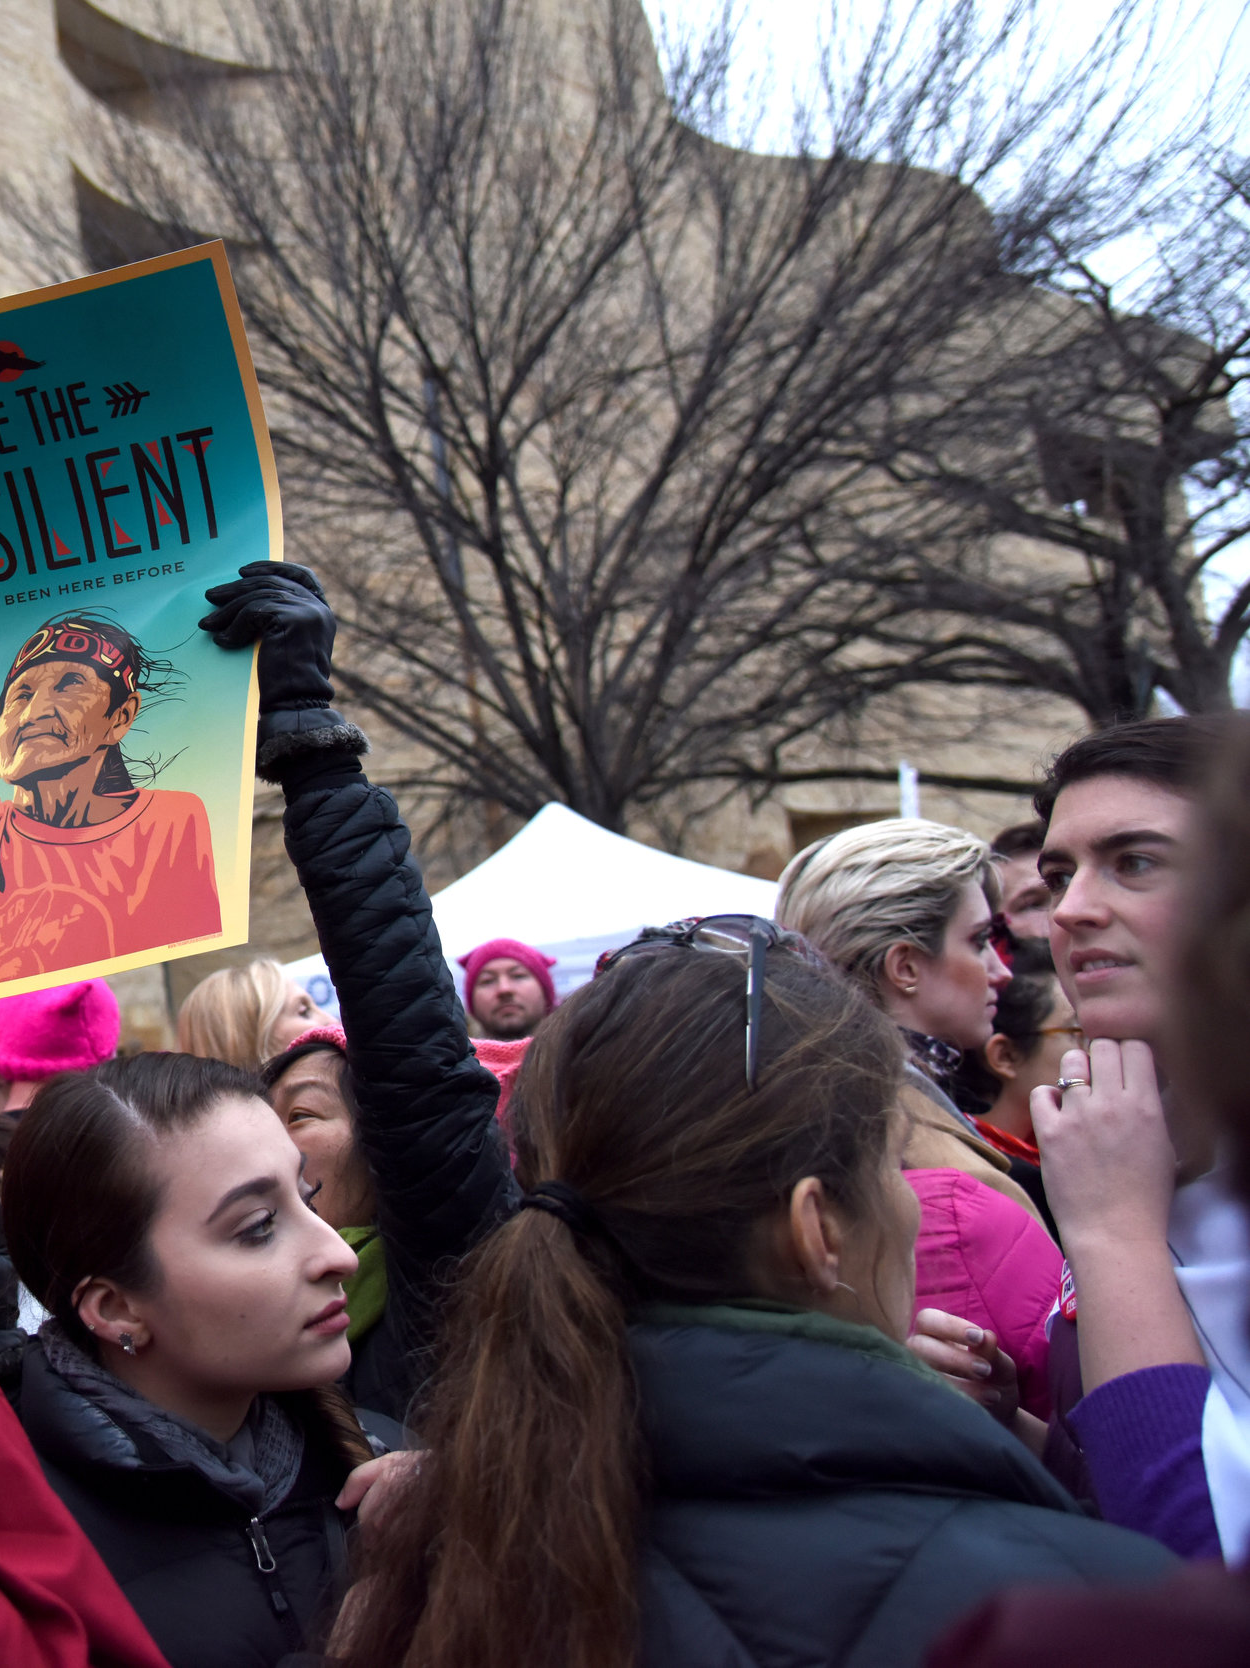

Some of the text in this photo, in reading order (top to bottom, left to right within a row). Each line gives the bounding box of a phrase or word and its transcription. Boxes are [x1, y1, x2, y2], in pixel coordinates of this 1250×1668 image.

[15, 381, 99, 446] THE
[5, 587, 52, 606] BEEN
[58, 576, 106, 595] HERE
[113, 561, 185, 585] BEFORE
